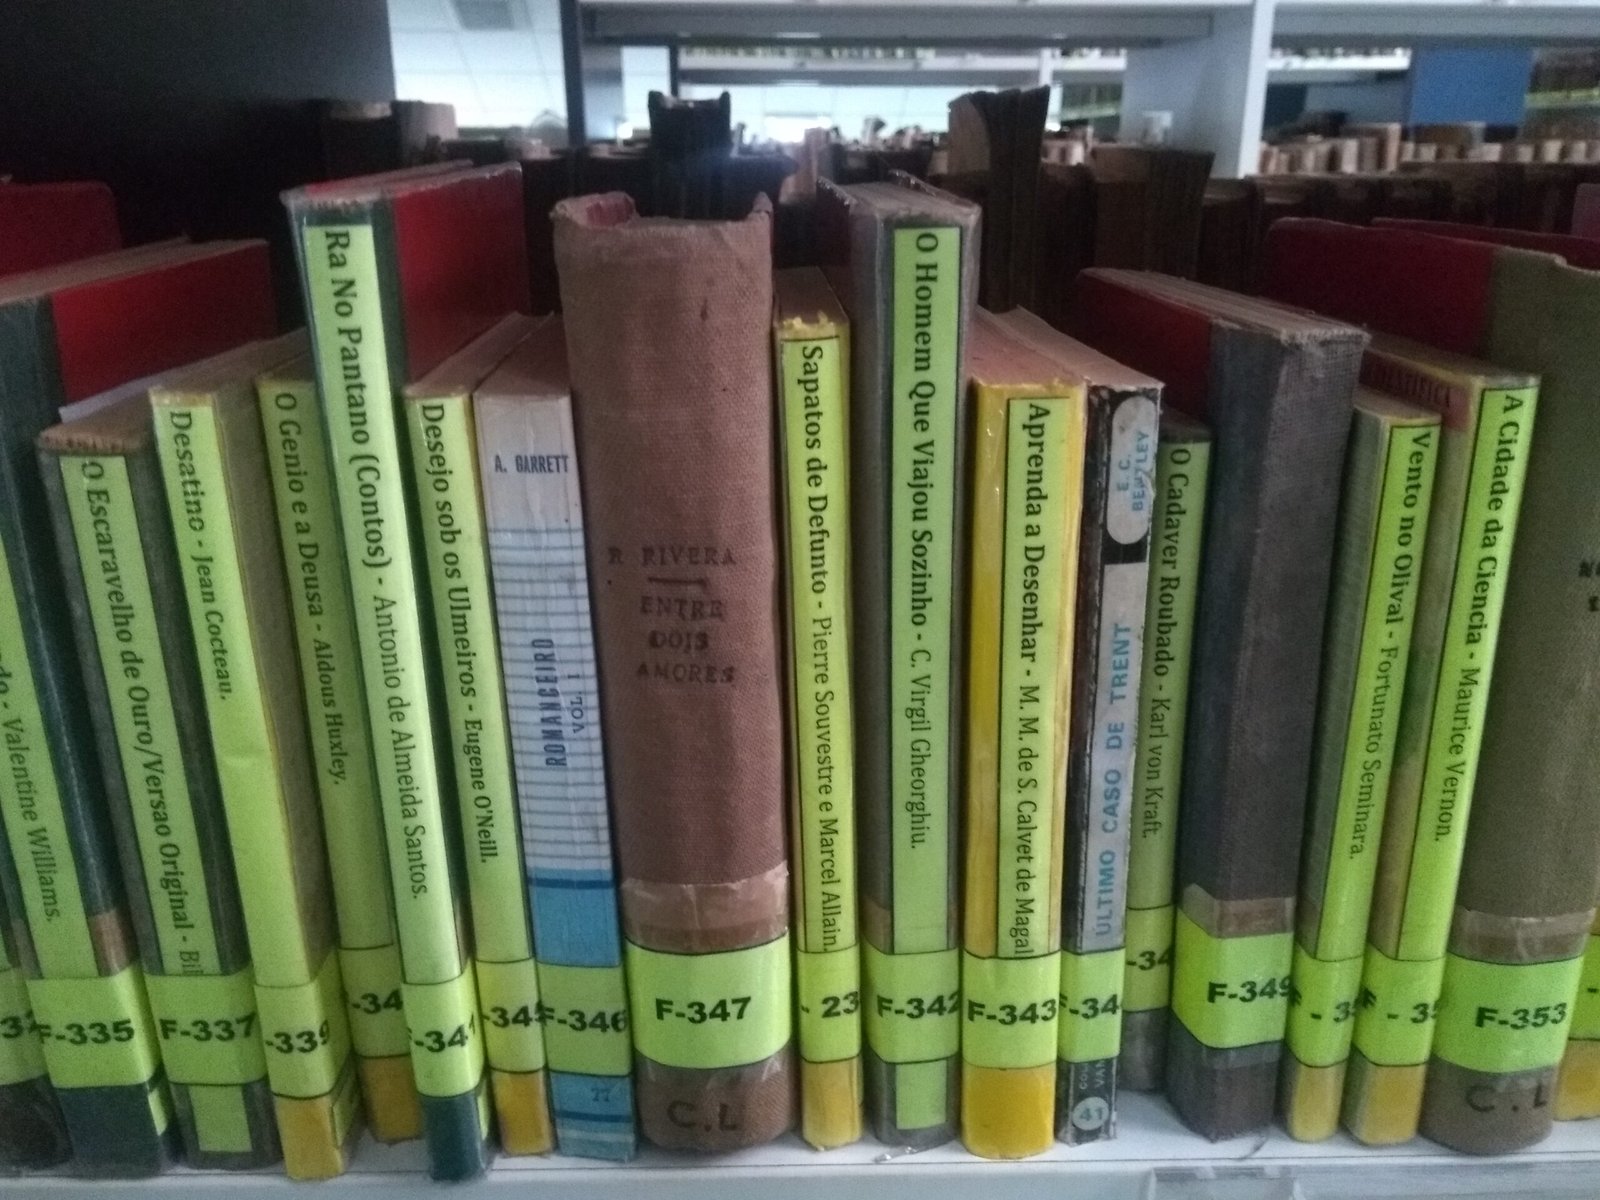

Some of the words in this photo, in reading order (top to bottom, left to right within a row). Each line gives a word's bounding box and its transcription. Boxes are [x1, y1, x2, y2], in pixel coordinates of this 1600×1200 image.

[325, 230, 350, 269] Ra
[915, 232, 939, 252] O
[330, 278, 358, 319] No
[914, 262, 938, 372] Homem
[275, 391, 298, 409] O
[337, 327, 370, 446] Pantano
[798, 345, 824, 450] Sapatos
[908, 383, 936, 432] Que
[1503, 394, 1523, 413] A
[81, 461, 105, 479] O
[279, 415, 305, 495] Genio
[422, 404, 453, 492] Desejo
[494, 455, 508, 473] A.
[515, 455, 569, 474] GARRETT
[806, 457, 828, 488] de
[907, 440, 935, 521] Viajou
[1023, 403, 1051, 516] Aprenda
[1170, 448, 1191, 465] O
[1403, 432, 1431, 509] Vento
[1488, 421, 1520, 511] Cidade
[292, 501, 309, 514] e
[295, 519, 312, 535] a
[348, 453, 391, 568] (Contos)
[436, 501, 462, 545] sob
[1024, 524, 1042, 537] a
[1161, 473, 1189, 570] Cadaver
[1397, 516, 1417, 547] no
[1481, 518, 1504, 549] da
[86, 486, 135, 643] Escaravelho
[170, 411, 205, 532] Desatino
[191, 554, 216, 605] Jean
[204, 609, 233, 700] Cocteau.
[443, 552, 461, 579] os
[641, 547, 737, 566] RIVERA
[808, 495, 830, 594] Defunto
[911, 530, 934, 625] Sozinho
[299, 543, 324, 616] Deusa
[640, 595, 723, 620] ENTRE
[1020, 546, 1046, 663] Desenhar
[1385, 554, 1413, 625] Olival
[1465, 556, 1497, 645] Ciencia
[374, 596, 400, 689] Antonio
[448, 586, 477, 698] Ulmeiros
[812, 617, 832, 684] Pierre
[910, 649, 931, 668] C.
[1153, 576, 1180, 678] Roubado
[121, 649, 144, 680] de
[313, 638, 336, 709] Aldous
[637, 663, 736, 684] AMORES
[1110, 623, 1131, 704] TRENT
[389, 694, 411, 723] de
[532, 638, 567, 767] ROMANCEIRO
[569, 691, 585, 733] VOL.
[905, 675, 931, 731] Virgil
[1018, 718, 1039, 742] M.
[1019, 685, 1040, 710] M.
[1151, 698, 1170, 740] Karl
[1366, 647, 1398, 754] Fortunato
[1449, 668, 1481, 755] Maurice
[128, 686, 172, 837] Ouro/Versao
[325, 713, 349, 785] Huxley.
[464, 719, 484, 790] Eugene
[815, 690, 834, 796] Souvestre
[1017, 747, 1039, 771] de
[1106, 721, 1126, 750] DE
[1147, 746, 1163, 780] von
[391, 728, 422, 819] Almeida
[818, 800, 833, 811] e
[905, 736, 931, 849] Gheorghiu.
[1016, 777, 1038, 794] S.
[1103, 768, 1122, 834] CASO
[1434, 761, 1466, 842] Vernon.
[2, 718, 38, 822] Valentine
[26, 826, 60, 921] Williams.
[474, 796, 498, 863] O'Neill.
[1015, 801, 1038, 865] Calvet
[1142, 787, 1164, 839] Kraft.
[1350, 759, 1382, 859] Seminara.
[403, 824, 428, 899] Santos.
[820, 818, 841, 885] Marcel
[1015, 870, 1036, 893] de
[159, 842, 195, 929] Original
[160, 1011, 256, 1042] F-337
[655, 997, 752, 1026] F-347
[967, 998, 1057, 1026] F-343
[1475, 1002, 1568, 1031] F-353
